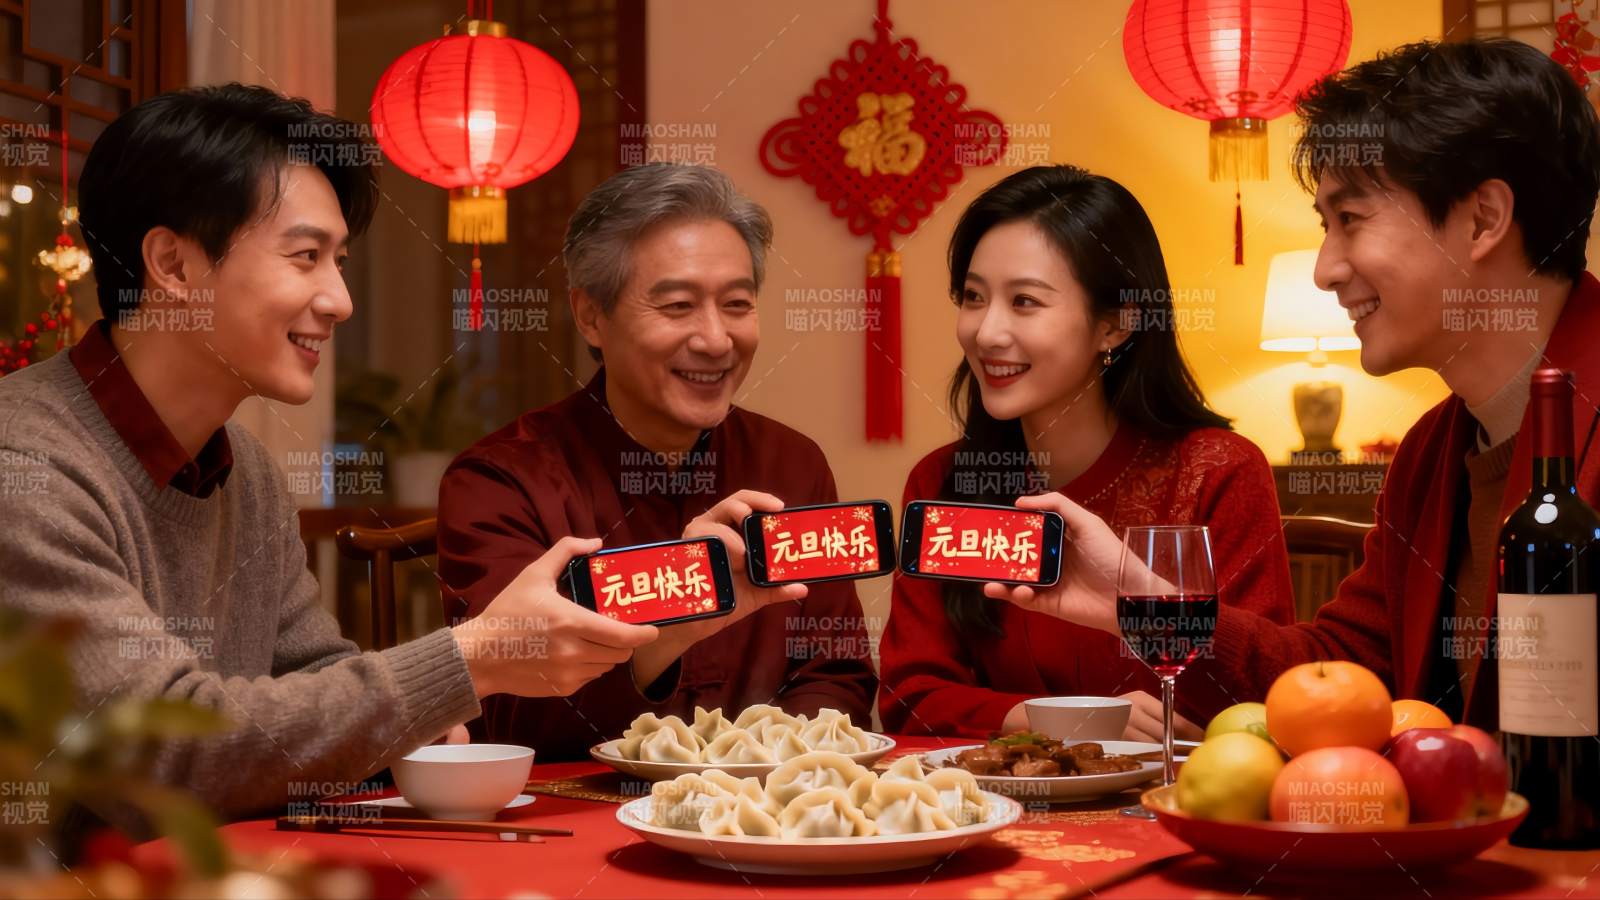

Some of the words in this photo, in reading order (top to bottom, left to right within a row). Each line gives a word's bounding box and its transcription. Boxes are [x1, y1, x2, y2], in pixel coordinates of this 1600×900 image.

[838, 92, 926, 177] 福
[771, 525, 876, 564] 元旦快乐
[928, 526, 1039, 565] 元旦快乐
[600, 562, 712, 608] 元旦快乐
